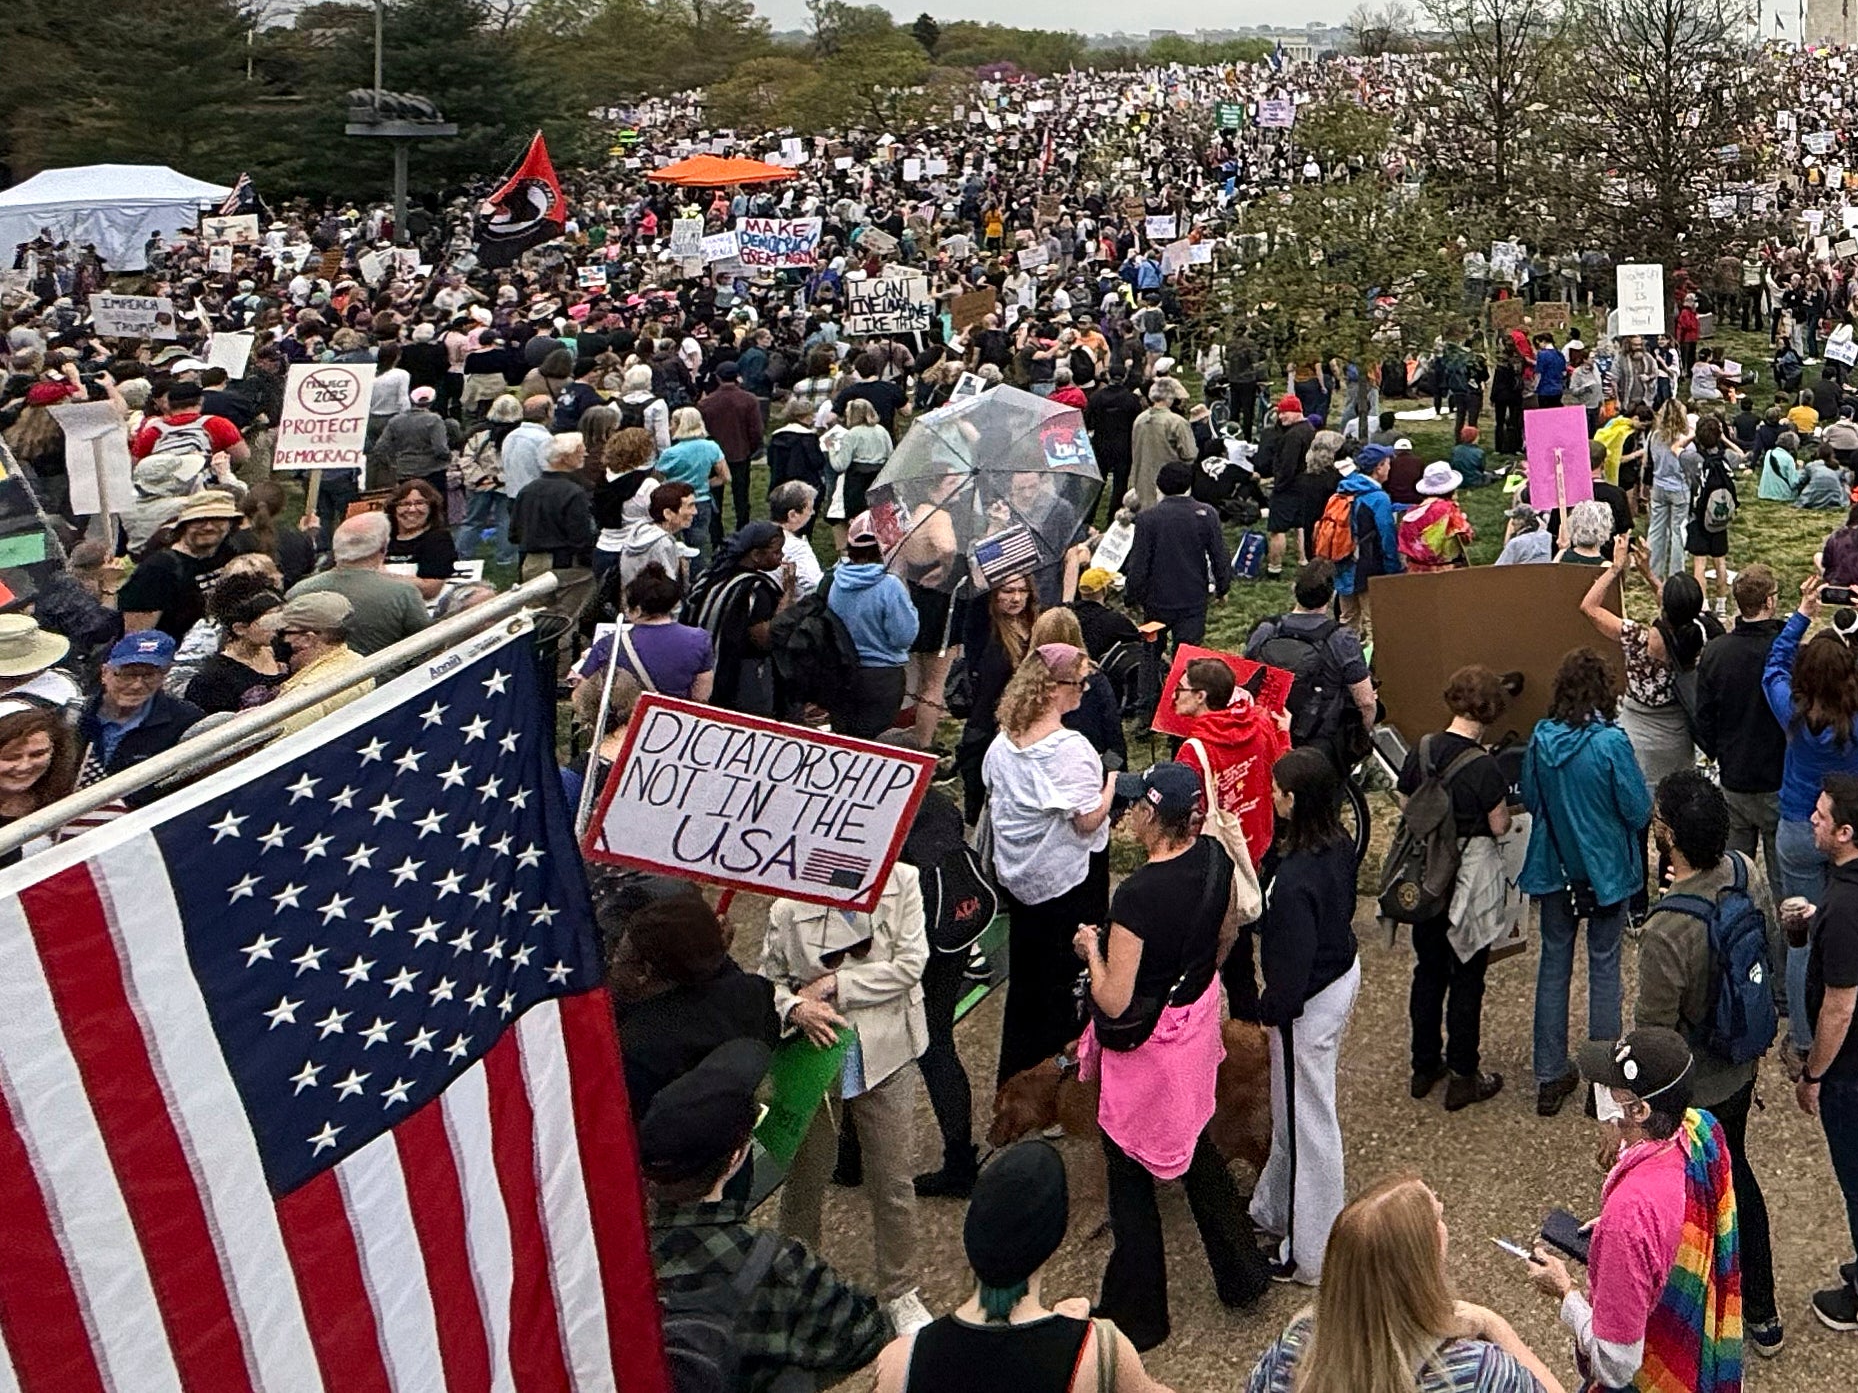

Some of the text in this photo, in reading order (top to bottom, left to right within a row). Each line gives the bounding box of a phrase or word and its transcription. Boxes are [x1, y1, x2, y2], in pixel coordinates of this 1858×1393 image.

[745, 219, 810, 238] MAKE
[740, 231, 818, 253] DEMOCRACY
[740, 247, 779, 266] GREAT
[850, 280, 867, 298] I
[101, 298, 159, 310] IMPEACH
[854, 316, 928, 333] LIKE THIS
[305, 379, 352, 389] PROJECT
[313, 389, 348, 403] 2025
[282, 417, 365, 435] PROTECT
[310, 434, 336, 444] OUR
[276, 449, 363, 464] DEMOCRACY
[429, 654, 463, 680] Annin
[640, 711, 916, 805] DICTATORSHIP
[620, 756, 876, 844] NOT IN THE
[671, 814, 798, 881] USA
